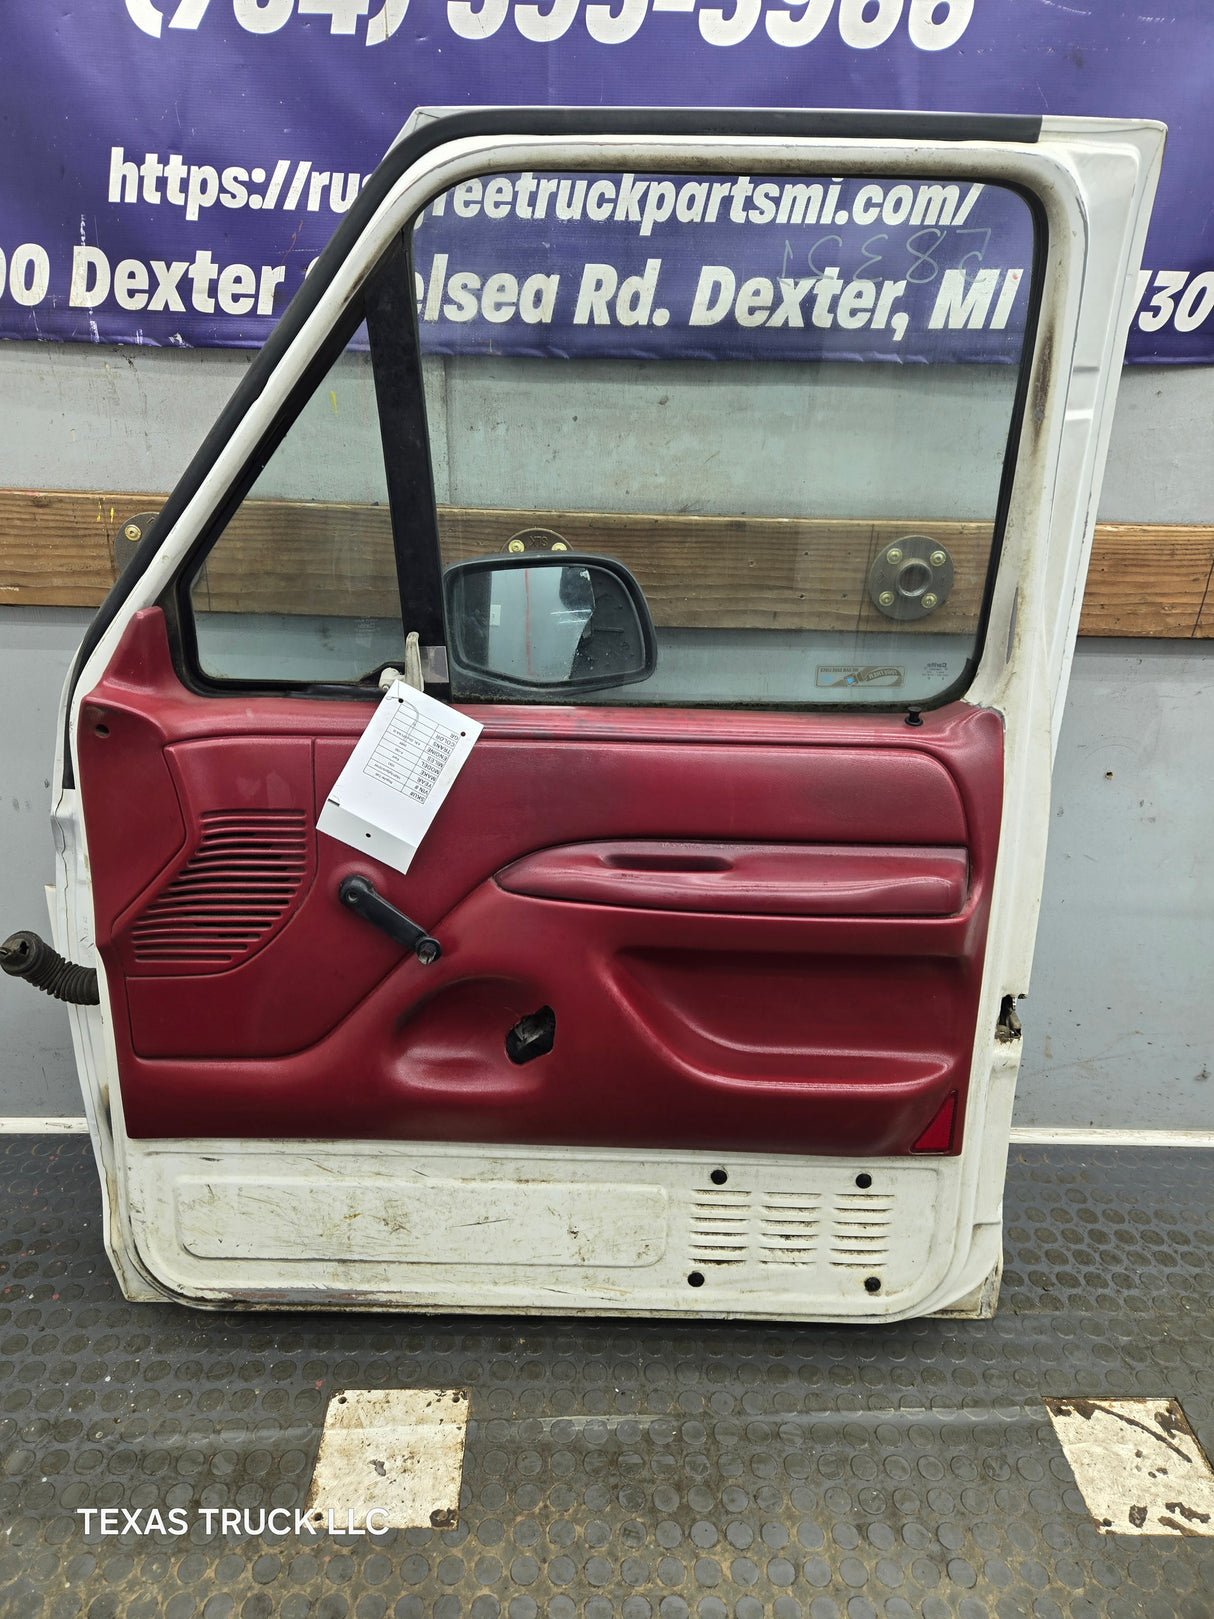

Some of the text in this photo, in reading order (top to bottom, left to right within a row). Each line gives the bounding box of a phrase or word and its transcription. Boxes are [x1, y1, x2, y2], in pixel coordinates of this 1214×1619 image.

[0, 243, 50, 306] 0
[69, 245, 285, 316] Dexter
[574, 258, 670, 328] Rd.
[689, 265, 909, 341] Dexter,
[928, 268, 1024, 330] MI
[434, 733, 455, 747] COLOR
[426, 746, 448, 761] ENGINE
[432, 741, 451, 754] TRANS
[419, 760, 440, 774] MODEL
[426, 755, 444, 767] MILES
[419, 769, 436, 781] MAKE
[416, 776, 433, 788] YEAR
[418, 786, 429, 795] VIN
